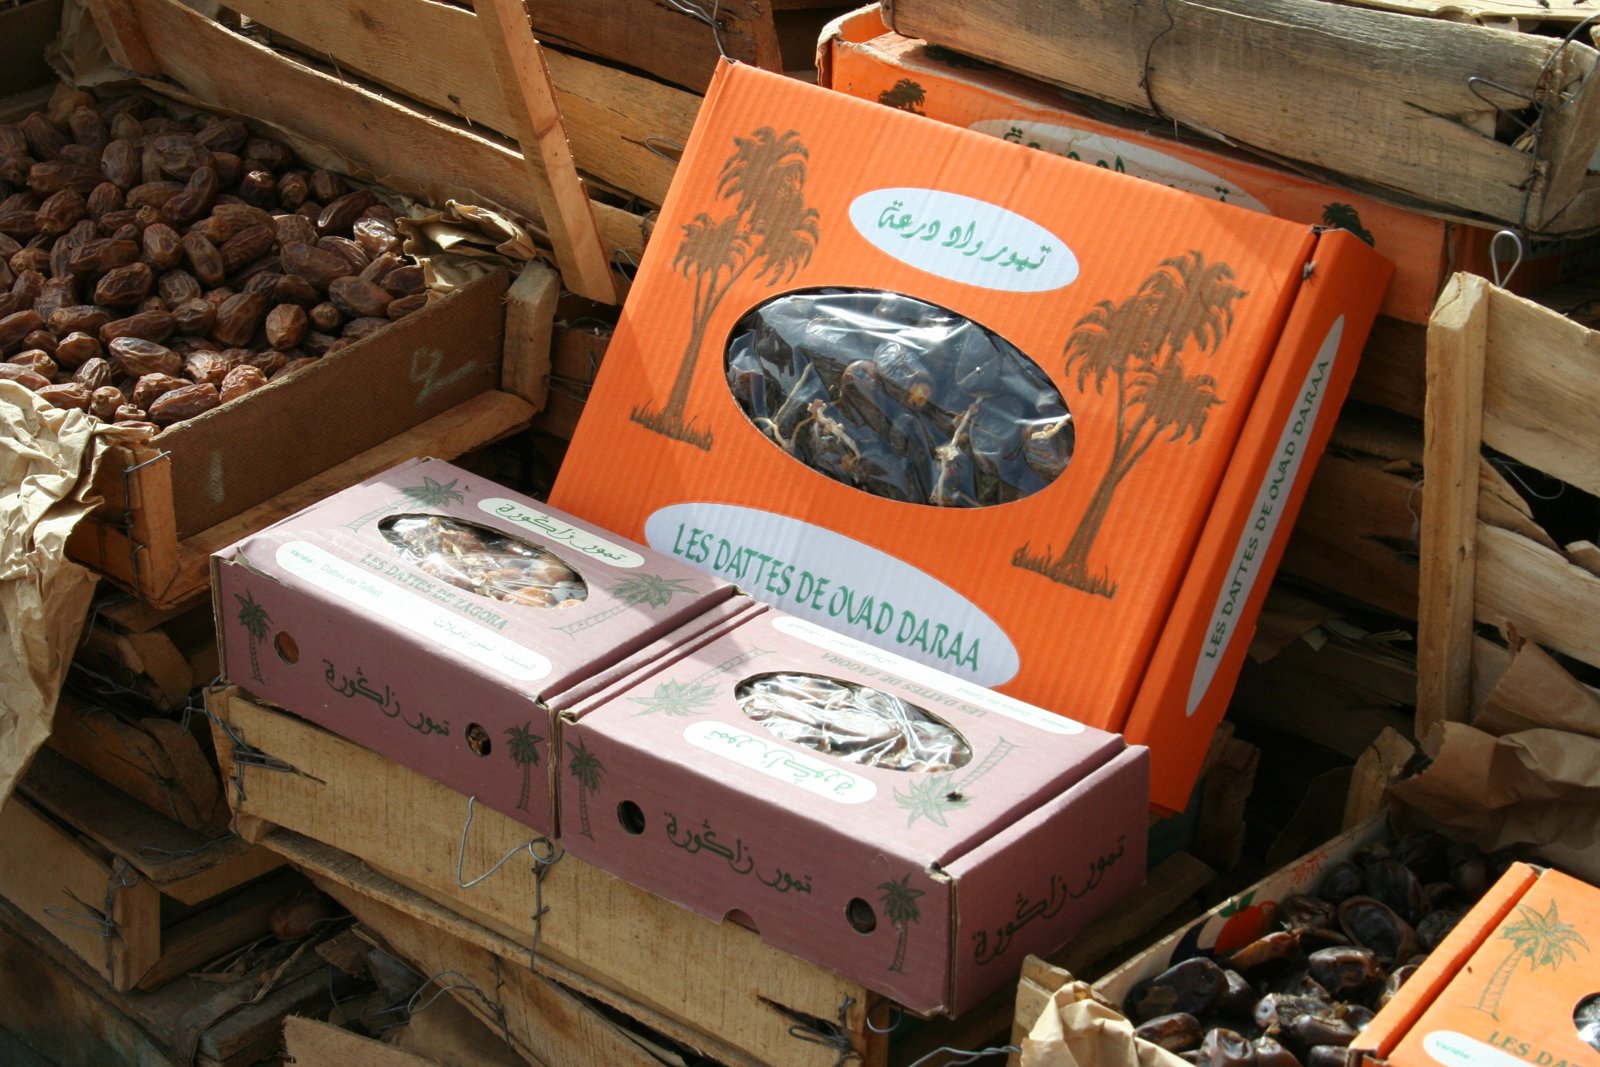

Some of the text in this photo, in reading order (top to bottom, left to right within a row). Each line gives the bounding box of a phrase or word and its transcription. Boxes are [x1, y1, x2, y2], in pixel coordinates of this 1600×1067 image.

[1205, 621, 1226, 659] LES
[1222, 537, 1259, 616] DATTES
[1255, 502, 1273, 533] DE
[1293, 361, 1329, 436] DARAA
[361, 553, 509, 630] LES DATTES DE ZAGORA
[672, 523, 714, 563] LES
[712, 538, 795, 596] DATTES
[794, 571, 831, 611] DE
[895, 609, 980, 672] DARAA
[1488, 1031, 1531, 1056] LES
